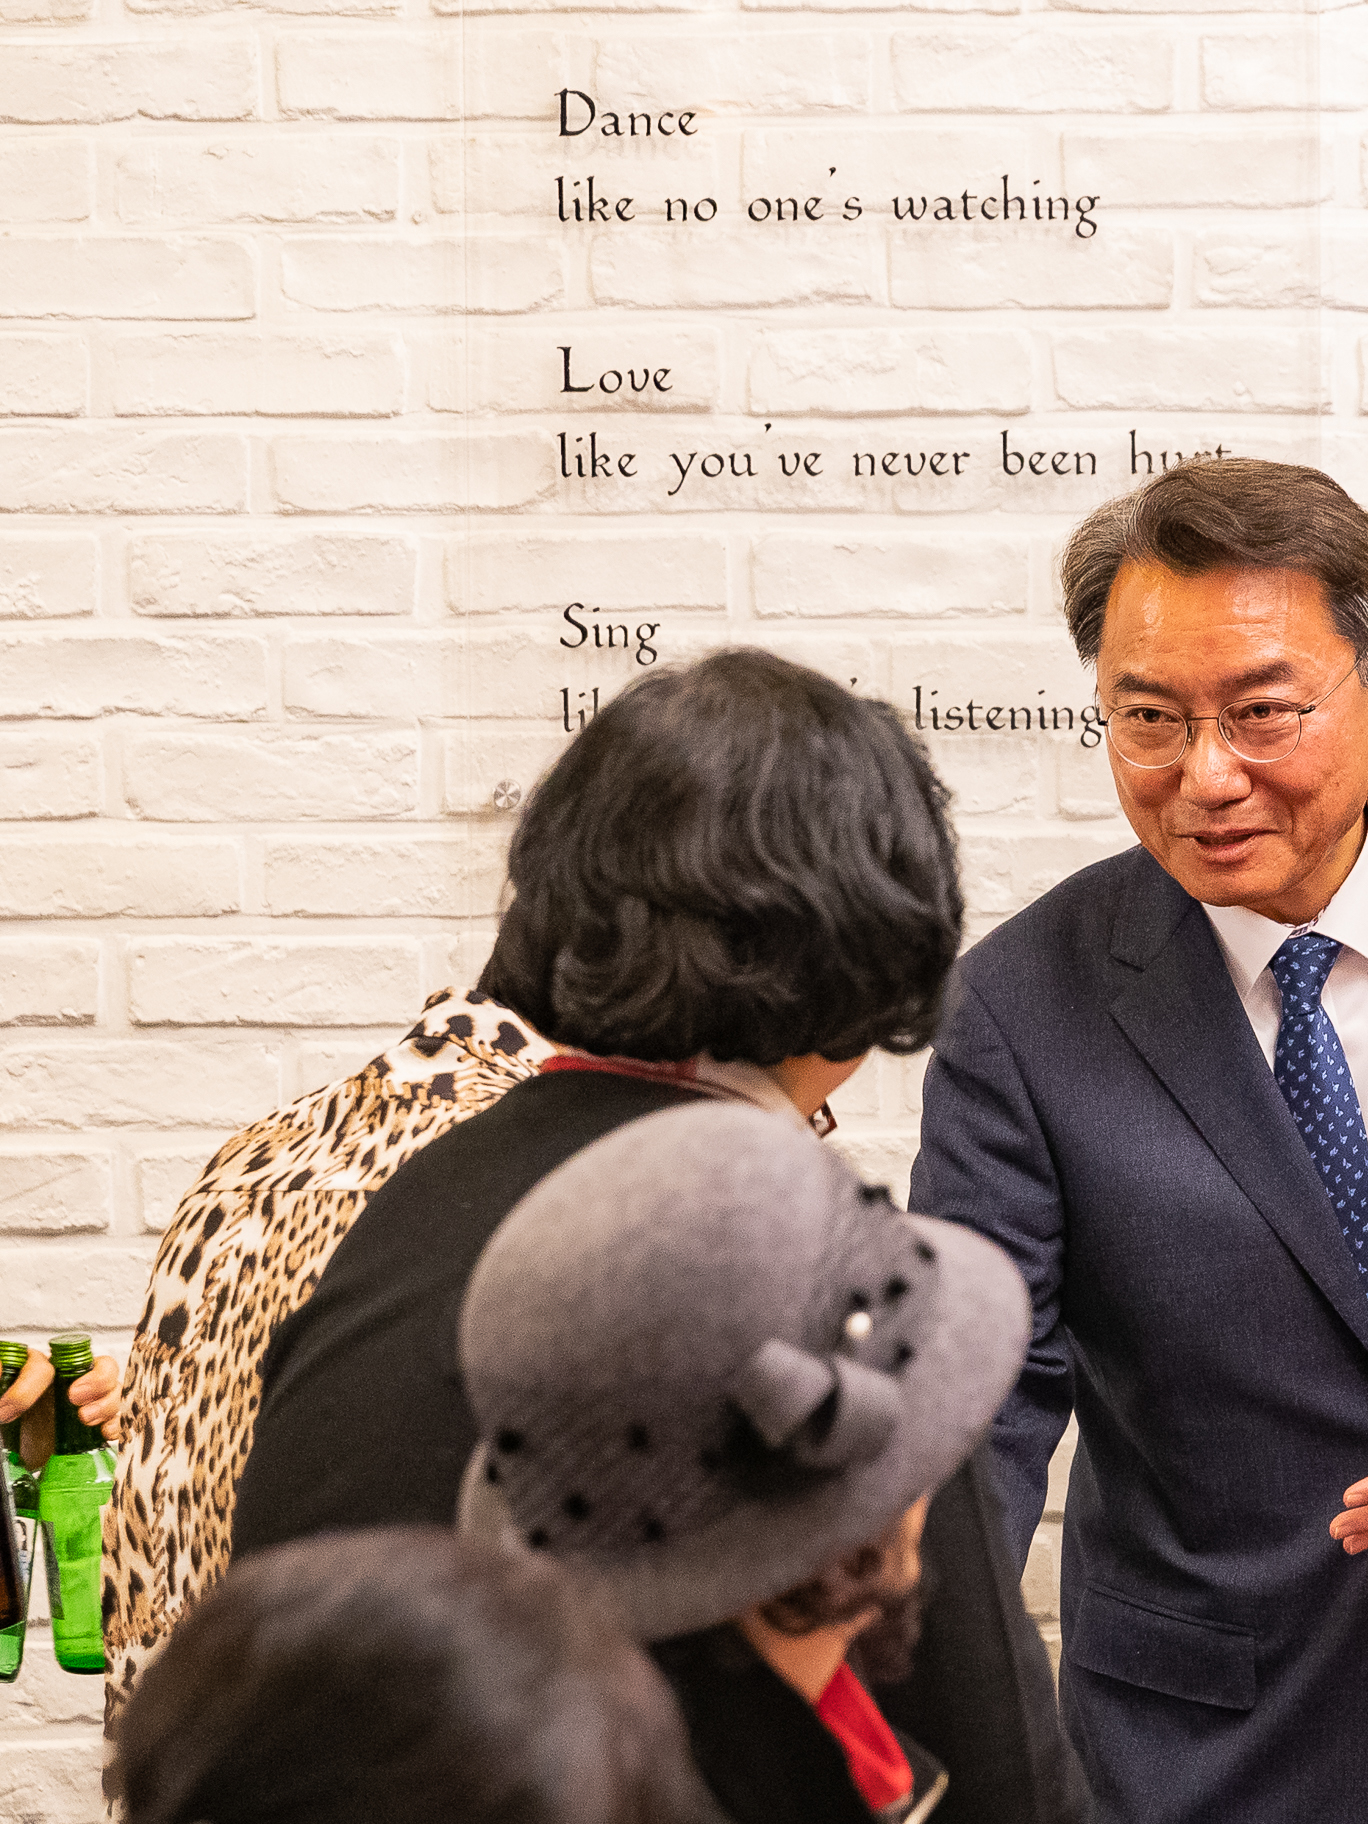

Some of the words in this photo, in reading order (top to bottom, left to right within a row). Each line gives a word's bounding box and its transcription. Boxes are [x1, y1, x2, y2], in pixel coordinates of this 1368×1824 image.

[557, 88, 699, 138] Dance
[554, 175, 636, 223] like
[664, 196, 719, 223] no
[747, 165, 864, 223] one's
[891, 173, 1101, 239] watching
[556, 346, 674, 394] Love
[556, 431, 638, 479] like
[667, 422, 824, 497] you've
[852, 450, 971, 478] never
[1000, 429, 1097, 477] been
[559, 602, 662, 666] Sing
[912, 684, 1102, 749] listening
